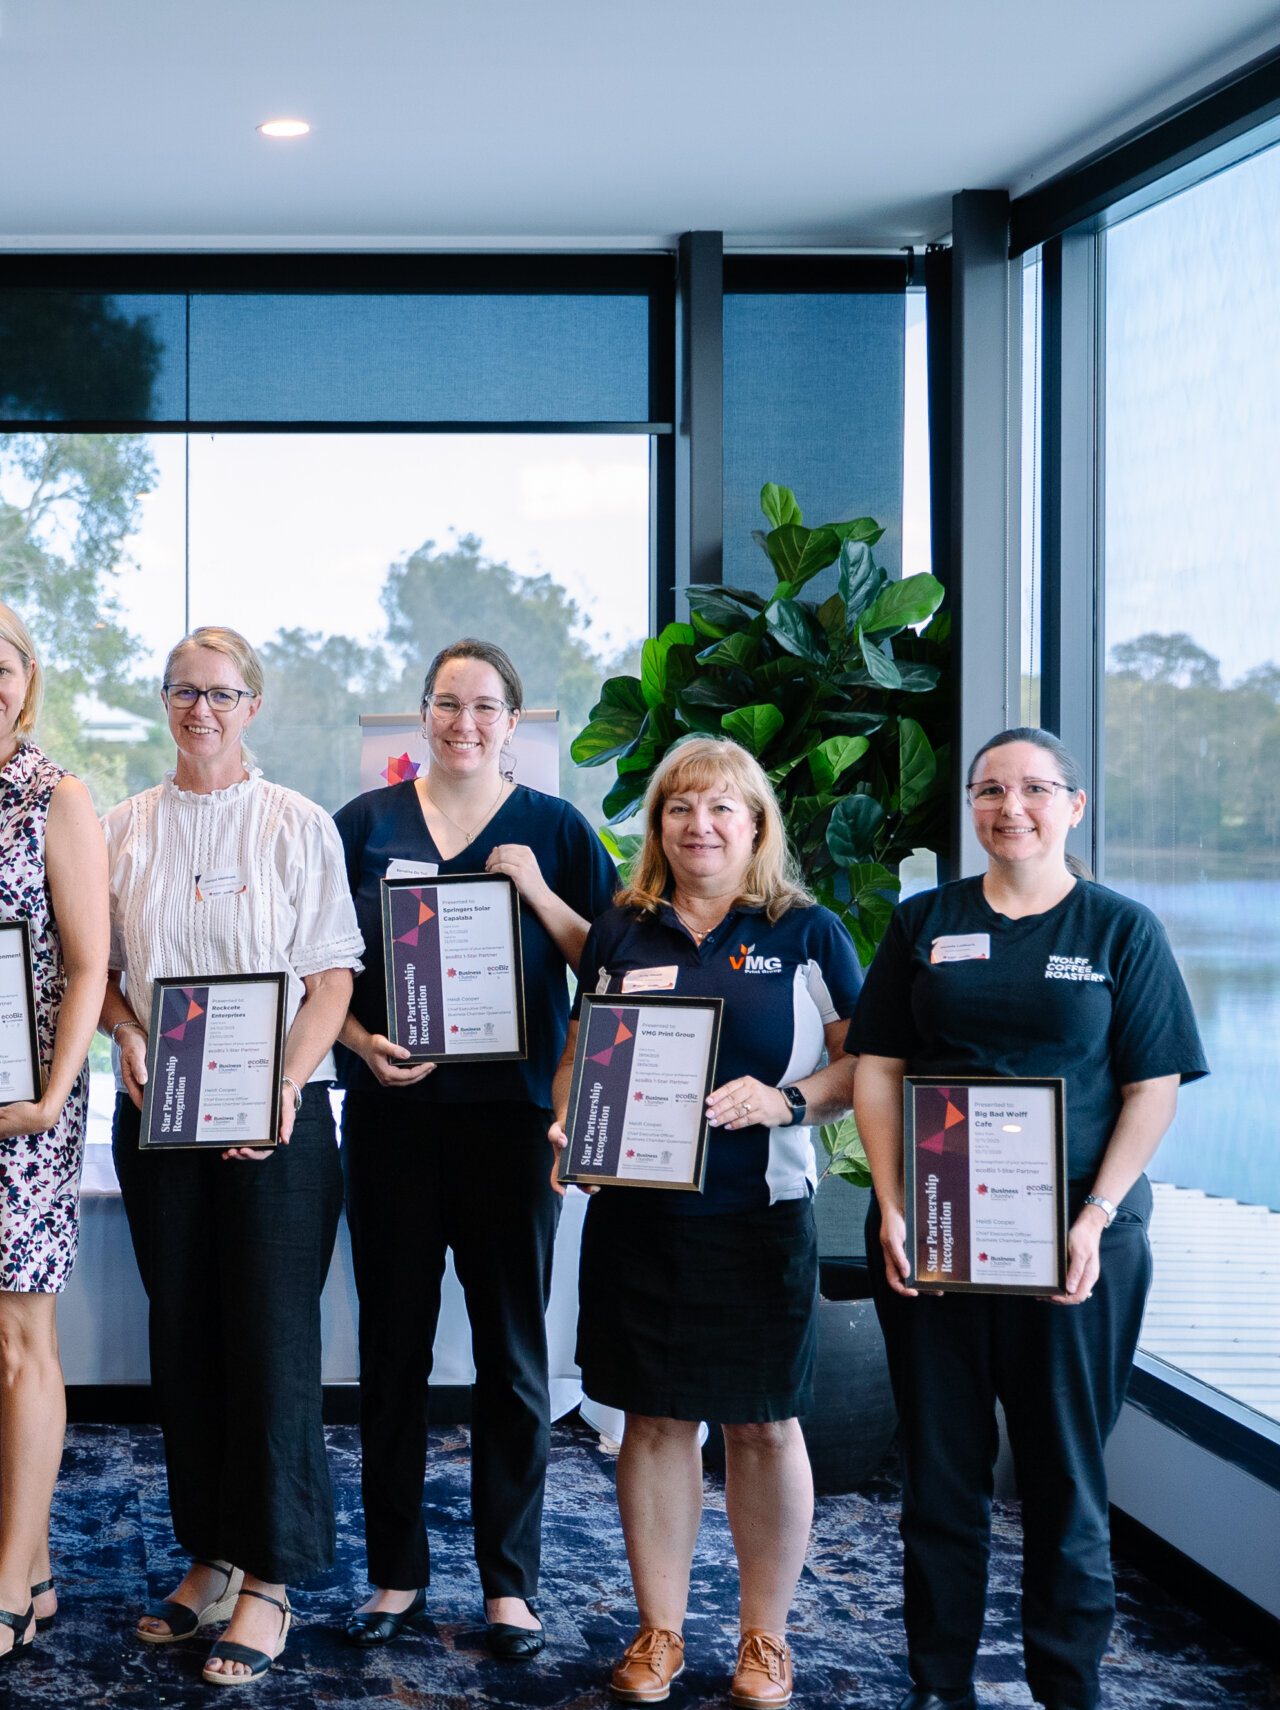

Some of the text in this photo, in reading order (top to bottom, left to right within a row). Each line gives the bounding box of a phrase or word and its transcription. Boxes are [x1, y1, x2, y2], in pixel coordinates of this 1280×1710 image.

[729, 955, 782, 970] VMG
[1046, 963, 1093, 974] COFFEE
[1048, 955, 1090, 967] WOLFF
[405, 963, 417, 1045] Star Partnership
[418, 985, 430, 1044] Recognition
[161, 1056, 178, 1132] Star Partnership
[173, 1077, 186, 1132] Recognition
[581, 1082, 603, 1166] Star Partnership
[593, 1106, 610, 1166] Recognition
[925, 1175, 939, 1272] Star Partnership
[940, 1202, 952, 1273] Recognition
